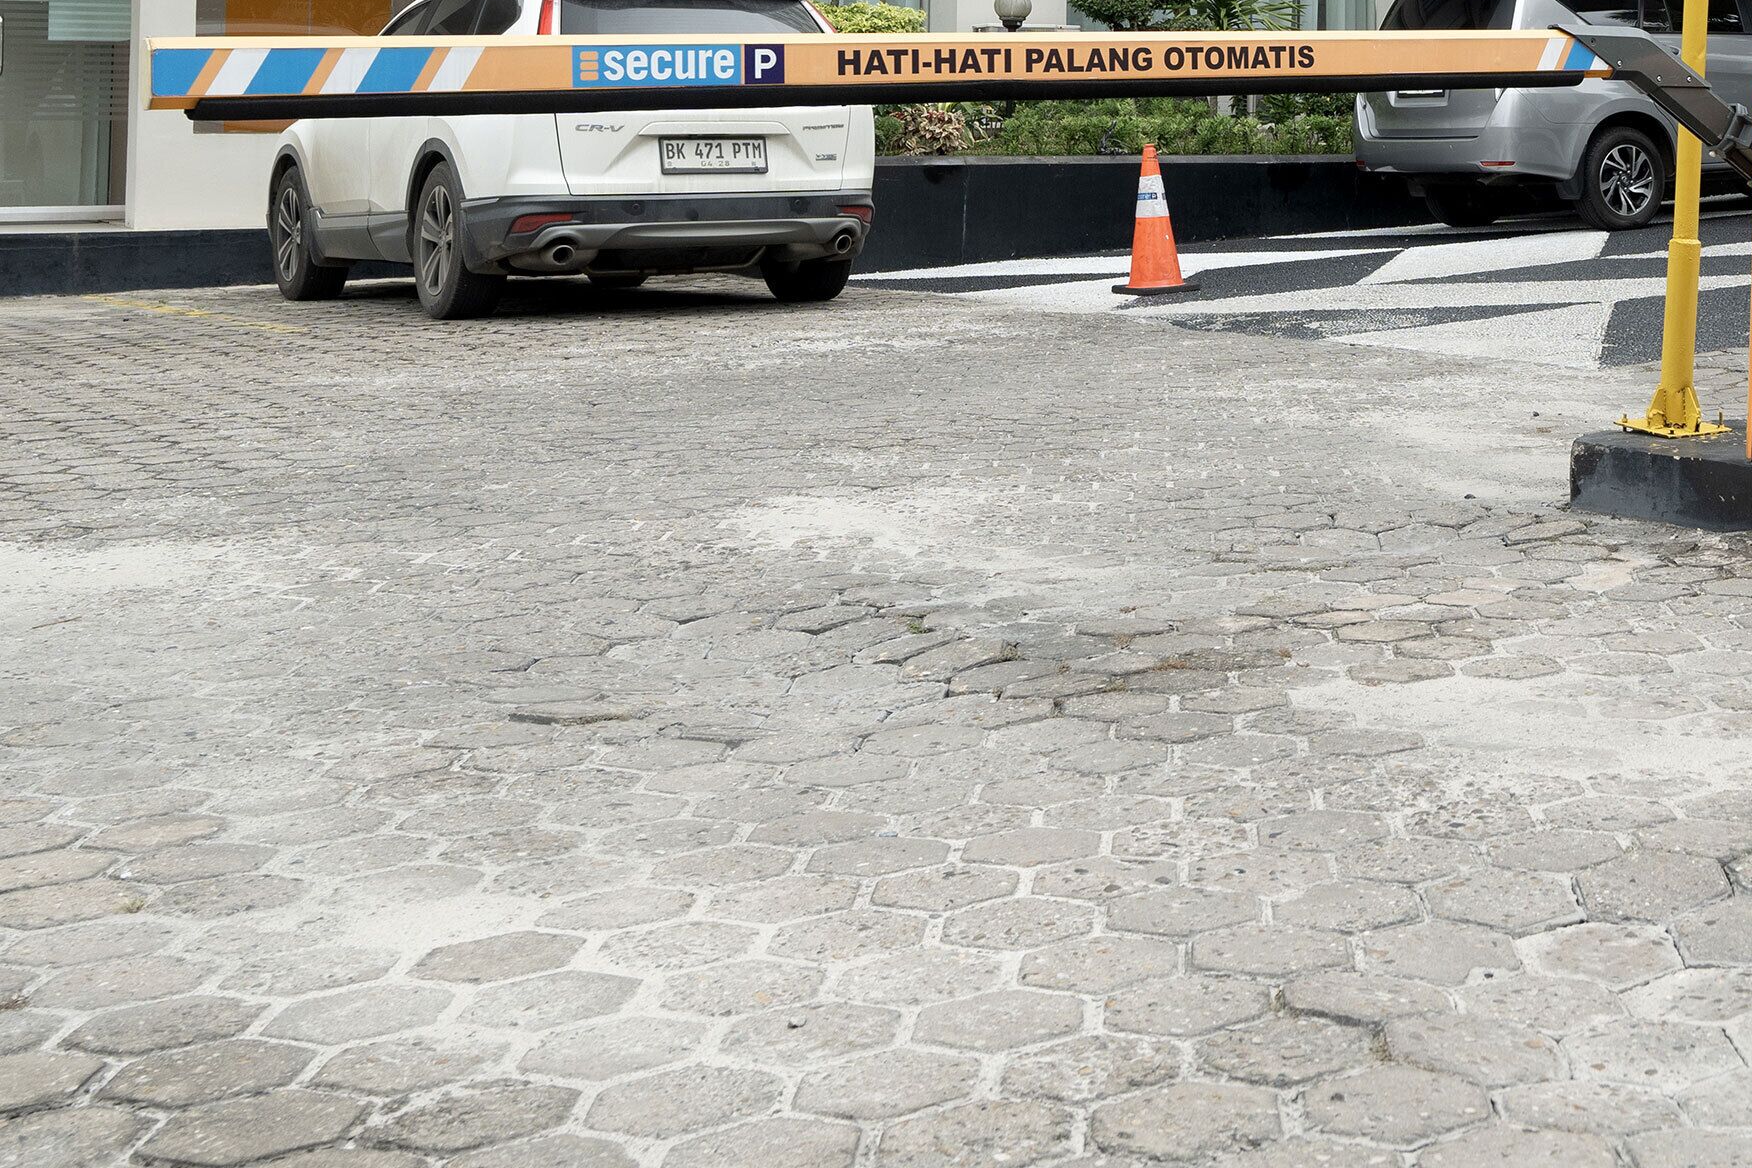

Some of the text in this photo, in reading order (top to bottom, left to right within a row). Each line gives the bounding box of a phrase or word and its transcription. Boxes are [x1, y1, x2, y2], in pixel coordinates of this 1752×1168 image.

[603, 45, 1315, 81] secure P HATI-HATI PALANG OTOMATIS
[574, 124, 625, 133] CR-V
[665, 141, 762, 160] BK 471 PTM
